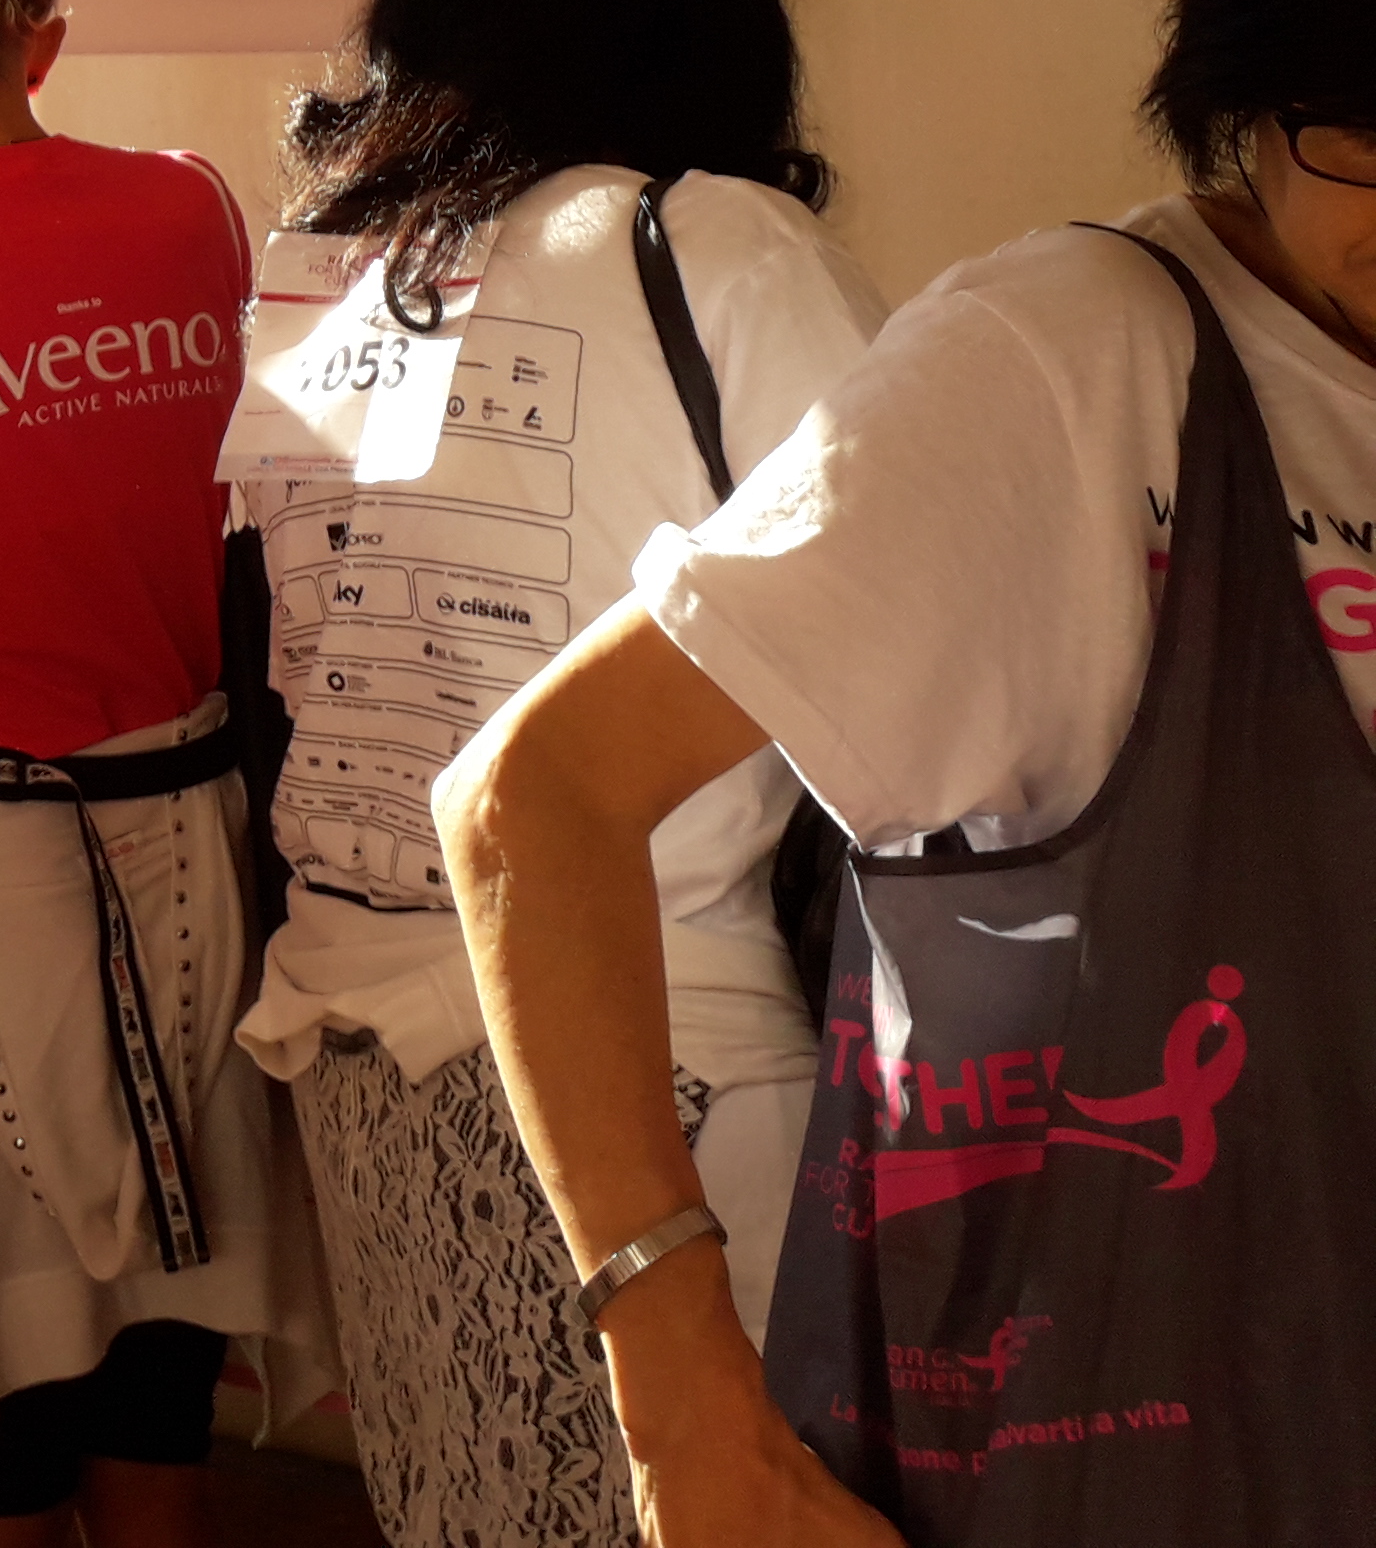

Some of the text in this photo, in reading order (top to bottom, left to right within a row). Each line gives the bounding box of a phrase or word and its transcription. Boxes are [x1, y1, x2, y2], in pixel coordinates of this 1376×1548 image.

[17, 374, 222, 429] ACTIVE NATURALS
[333, 580, 365, 606] ky
[987, 1415, 1085, 1452] alvarti
[1123, 1400, 1190, 1430] vita
